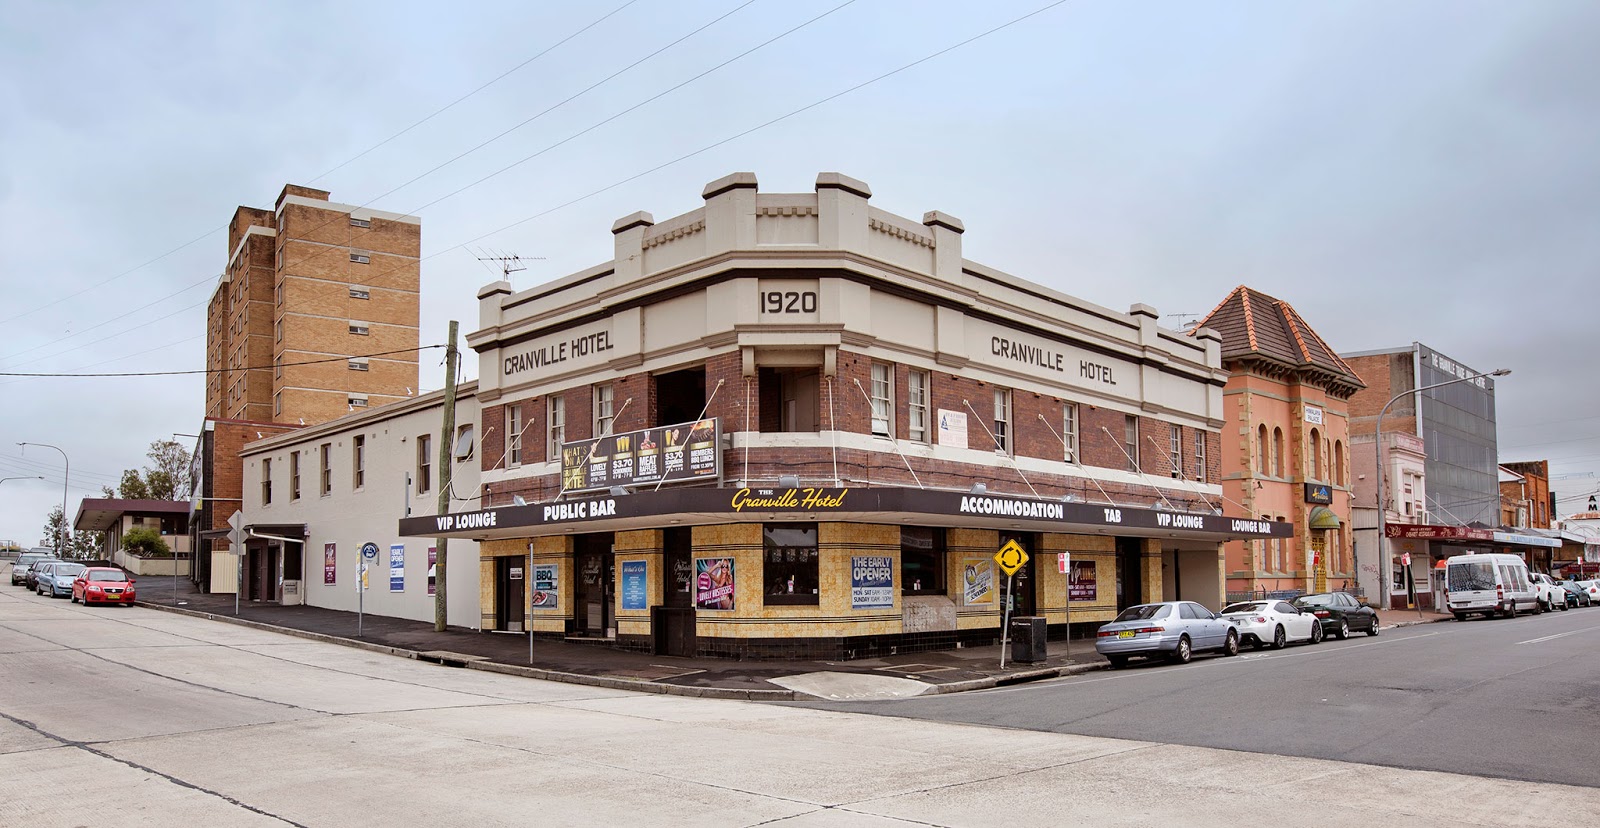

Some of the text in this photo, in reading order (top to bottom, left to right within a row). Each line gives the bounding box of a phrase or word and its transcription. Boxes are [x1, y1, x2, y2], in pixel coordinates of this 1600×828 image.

[761, 292, 817, 313] 1920
[504, 331, 614, 376] GRANVILLE HOTEL
[991, 336, 1117, 385] GRANVILLE HOTEL
[613, 459, 633, 469] $3.70
[640, 455, 657, 466] MEAT
[665, 452, 684, 463] $3.70
[732, 488, 849, 512] Granville Hotel
[544, 499, 616, 521] PUBLIC BAR
[960, 497, 1063, 519] ACCOMMODATION
[437, 512, 497, 530] VIP LOUNGE
[1104, 509, 1122, 523] TAB
[1157, 513, 1203, 529] VIP LOUNGE
[1231, 519, 1272, 533] LOUNGE BAR
[853, 557, 890, 568] THE EARLY
[536, 570, 552, 580] BBQ
[854, 567, 891, 581] OPENER
